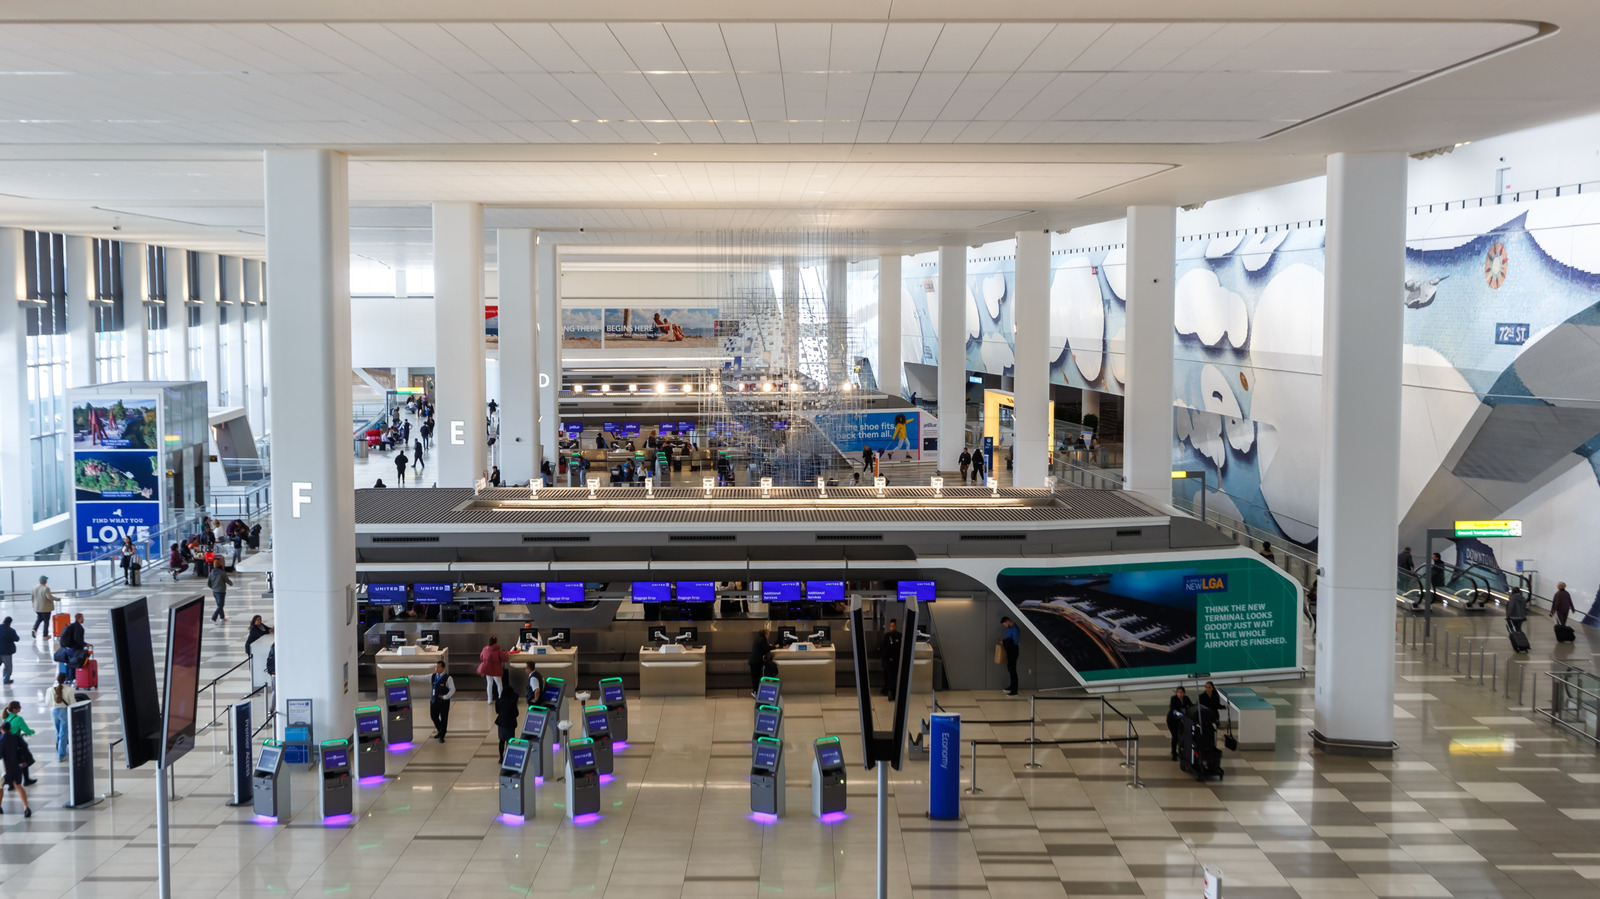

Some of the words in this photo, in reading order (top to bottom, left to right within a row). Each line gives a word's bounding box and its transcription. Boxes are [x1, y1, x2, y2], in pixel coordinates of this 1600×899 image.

[606, 324, 634, 332] BEGINS
[635, 324, 654, 332] HERE
[538, 372, 550, 388] D
[859, 423, 879, 431] shoe
[450, 421, 465, 445] E
[857, 431, 879, 439] them
[880, 430, 893, 439] all.
[291, 482, 313, 518] F
[86, 525, 150, 543] LOVE
[1185, 582, 1202, 591] NEW
[1202, 577, 1224, 590] LGA
[1204, 605, 1230, 613] THINK
[1231, 604, 1246, 612] THE
[1247, 603, 1266, 611] NEW
[1204, 613, 1245, 622] TERMINAL
[1246, 611, 1273, 620] LOOKS
[1204, 622, 1232, 631] GOOD?
[1233, 621, 1251, 630] JUST
[1253, 620, 1274, 628] WAIT
[1204, 632, 1220, 640] TILL
[1221, 631, 1237, 639] THE
[1238, 629, 1266, 638] WHOLE
[1204, 640, 1239, 649] AIRPORT
[1240, 639, 1248, 647] IS
[1249, 637, 1288, 646] FINISHED.
[940, 732, 950, 770] Economy
